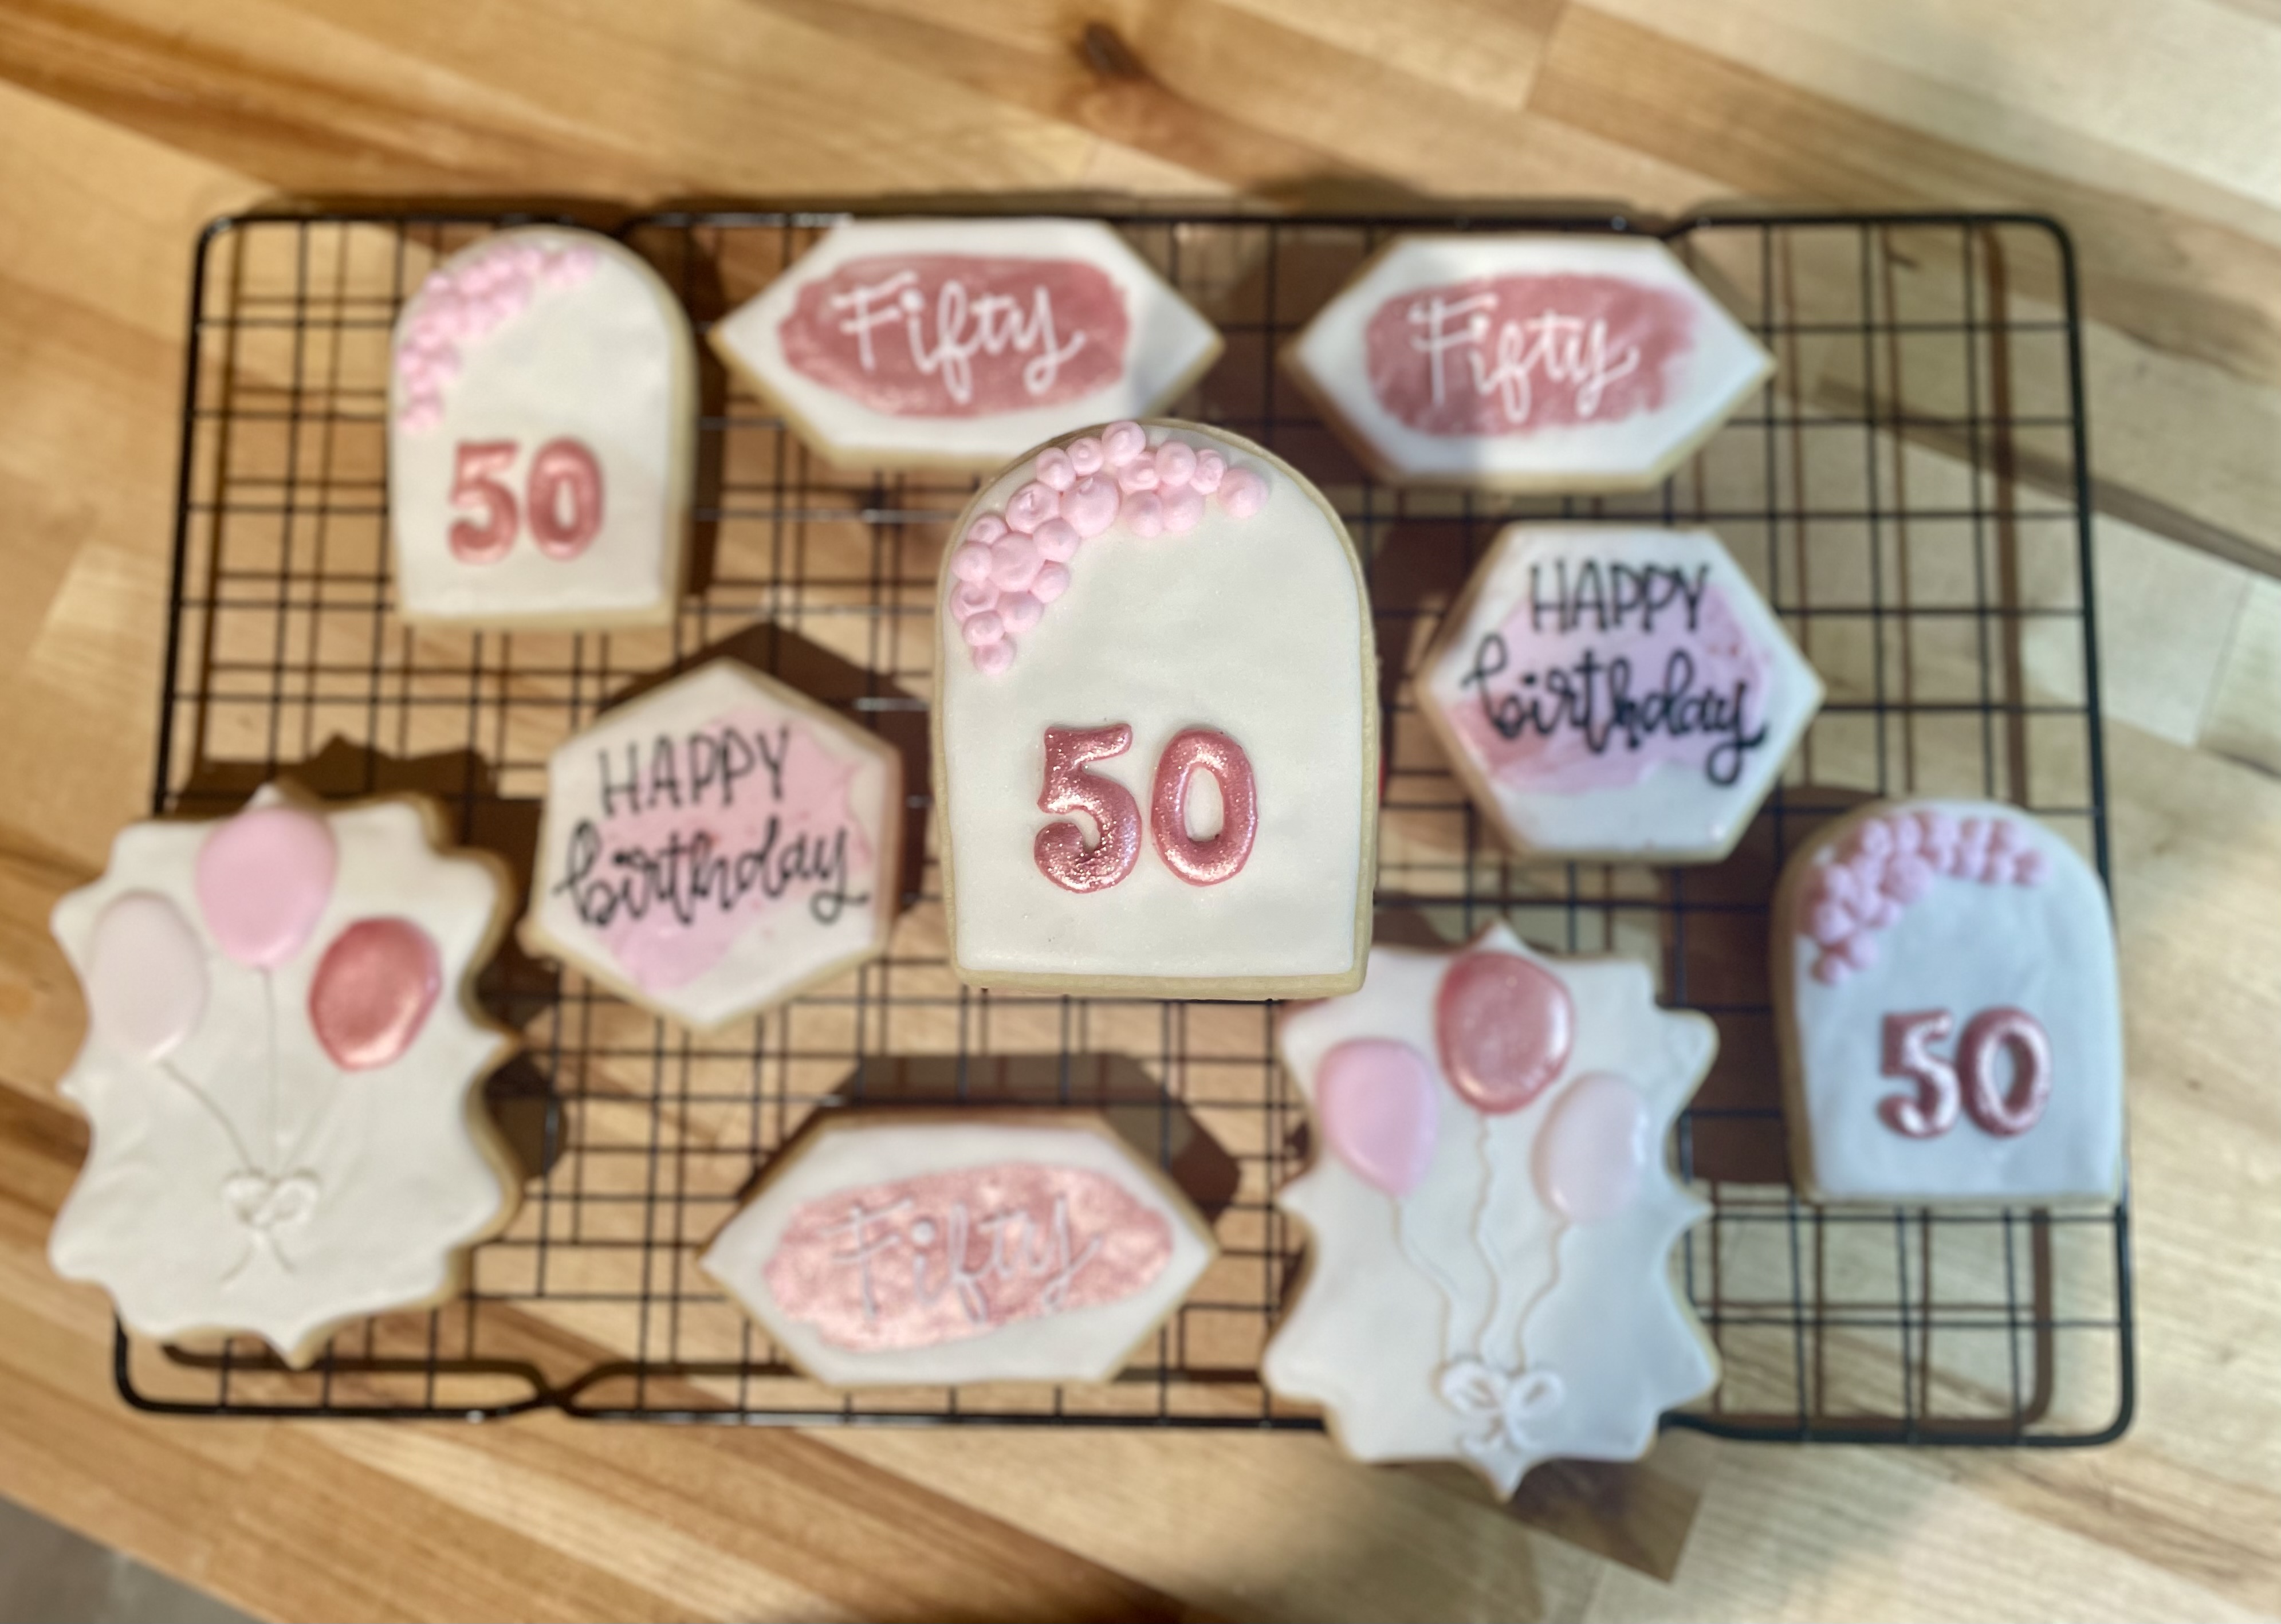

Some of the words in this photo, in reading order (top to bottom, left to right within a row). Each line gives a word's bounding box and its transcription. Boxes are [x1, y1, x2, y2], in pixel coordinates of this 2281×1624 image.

[830, 268, 1088, 404] Fifty
[1407, 291, 1641, 425] Fifty
[447, 434, 605, 564] 50
[1527, 557, 1710, 635] HAPPY
[598, 724, 789, 817] HAPPY
[1460, 632, 1771, 788] birthday
[552, 813, 871, 928] birthday
[1033, 722, 1258, 894] 50
[1875, 1004, 2053, 1141] 50
[819, 1193, 1104, 1323] Fifty
